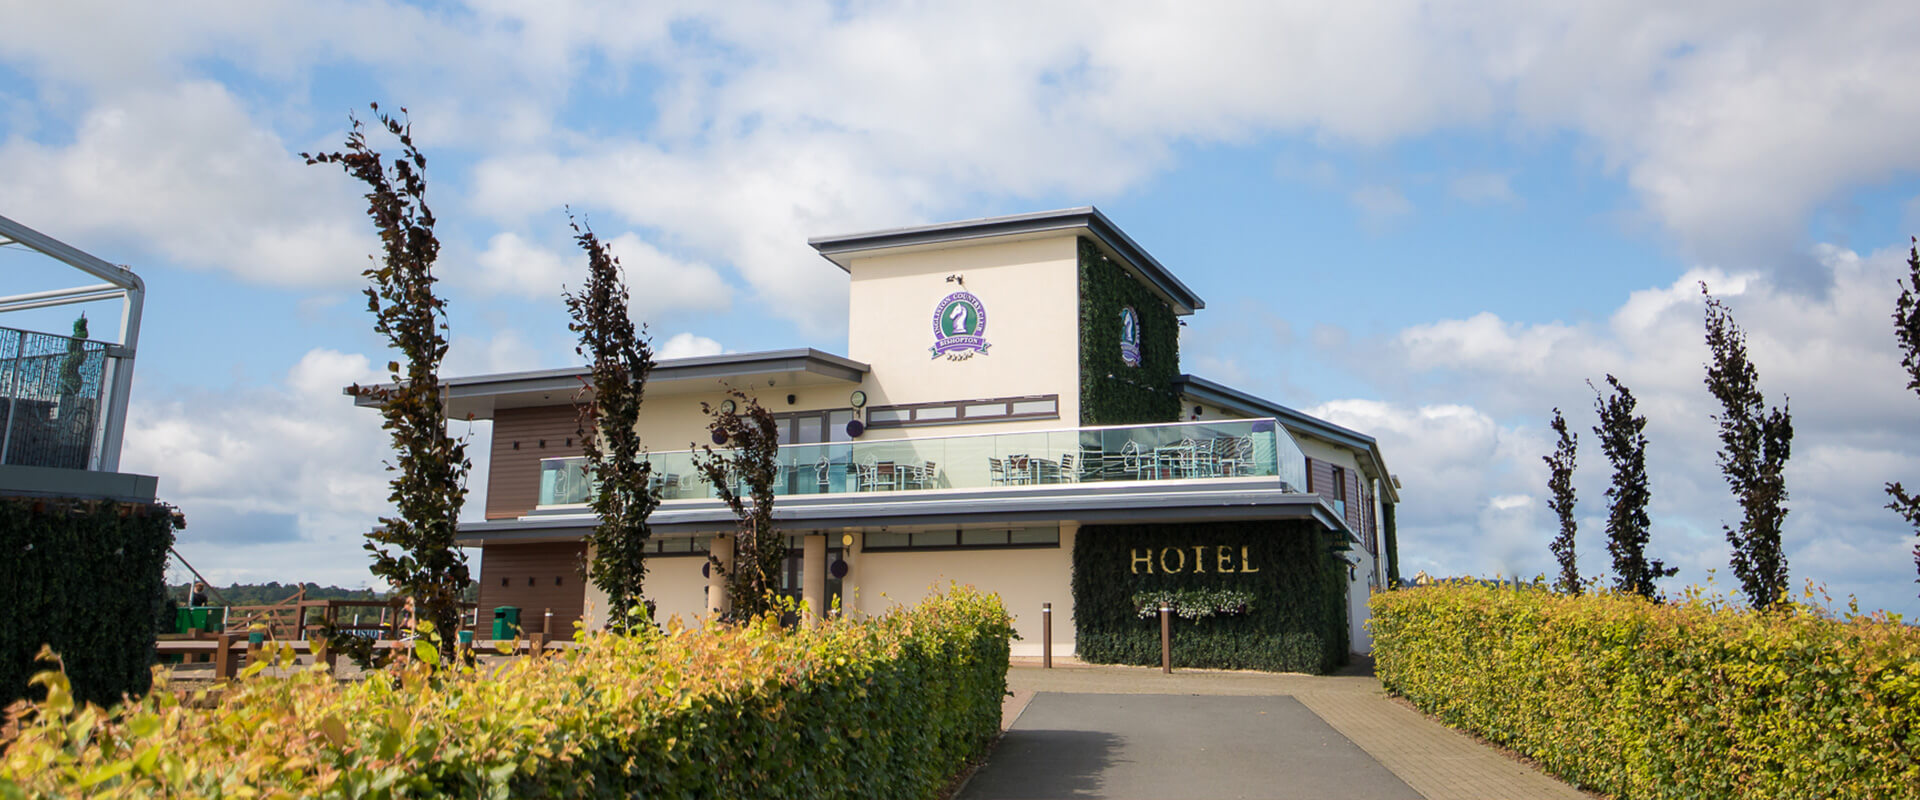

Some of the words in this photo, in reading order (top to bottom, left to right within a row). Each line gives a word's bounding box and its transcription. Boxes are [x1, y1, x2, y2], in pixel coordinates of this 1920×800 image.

[934, 297, 951, 335] INGLISTON
[953, 293, 981, 310] COUNTRY
[977, 311, 985, 331] CLUB
[940, 337, 978, 347] BISHOPTON
[1131, 545, 1260, 574] HOTEL
